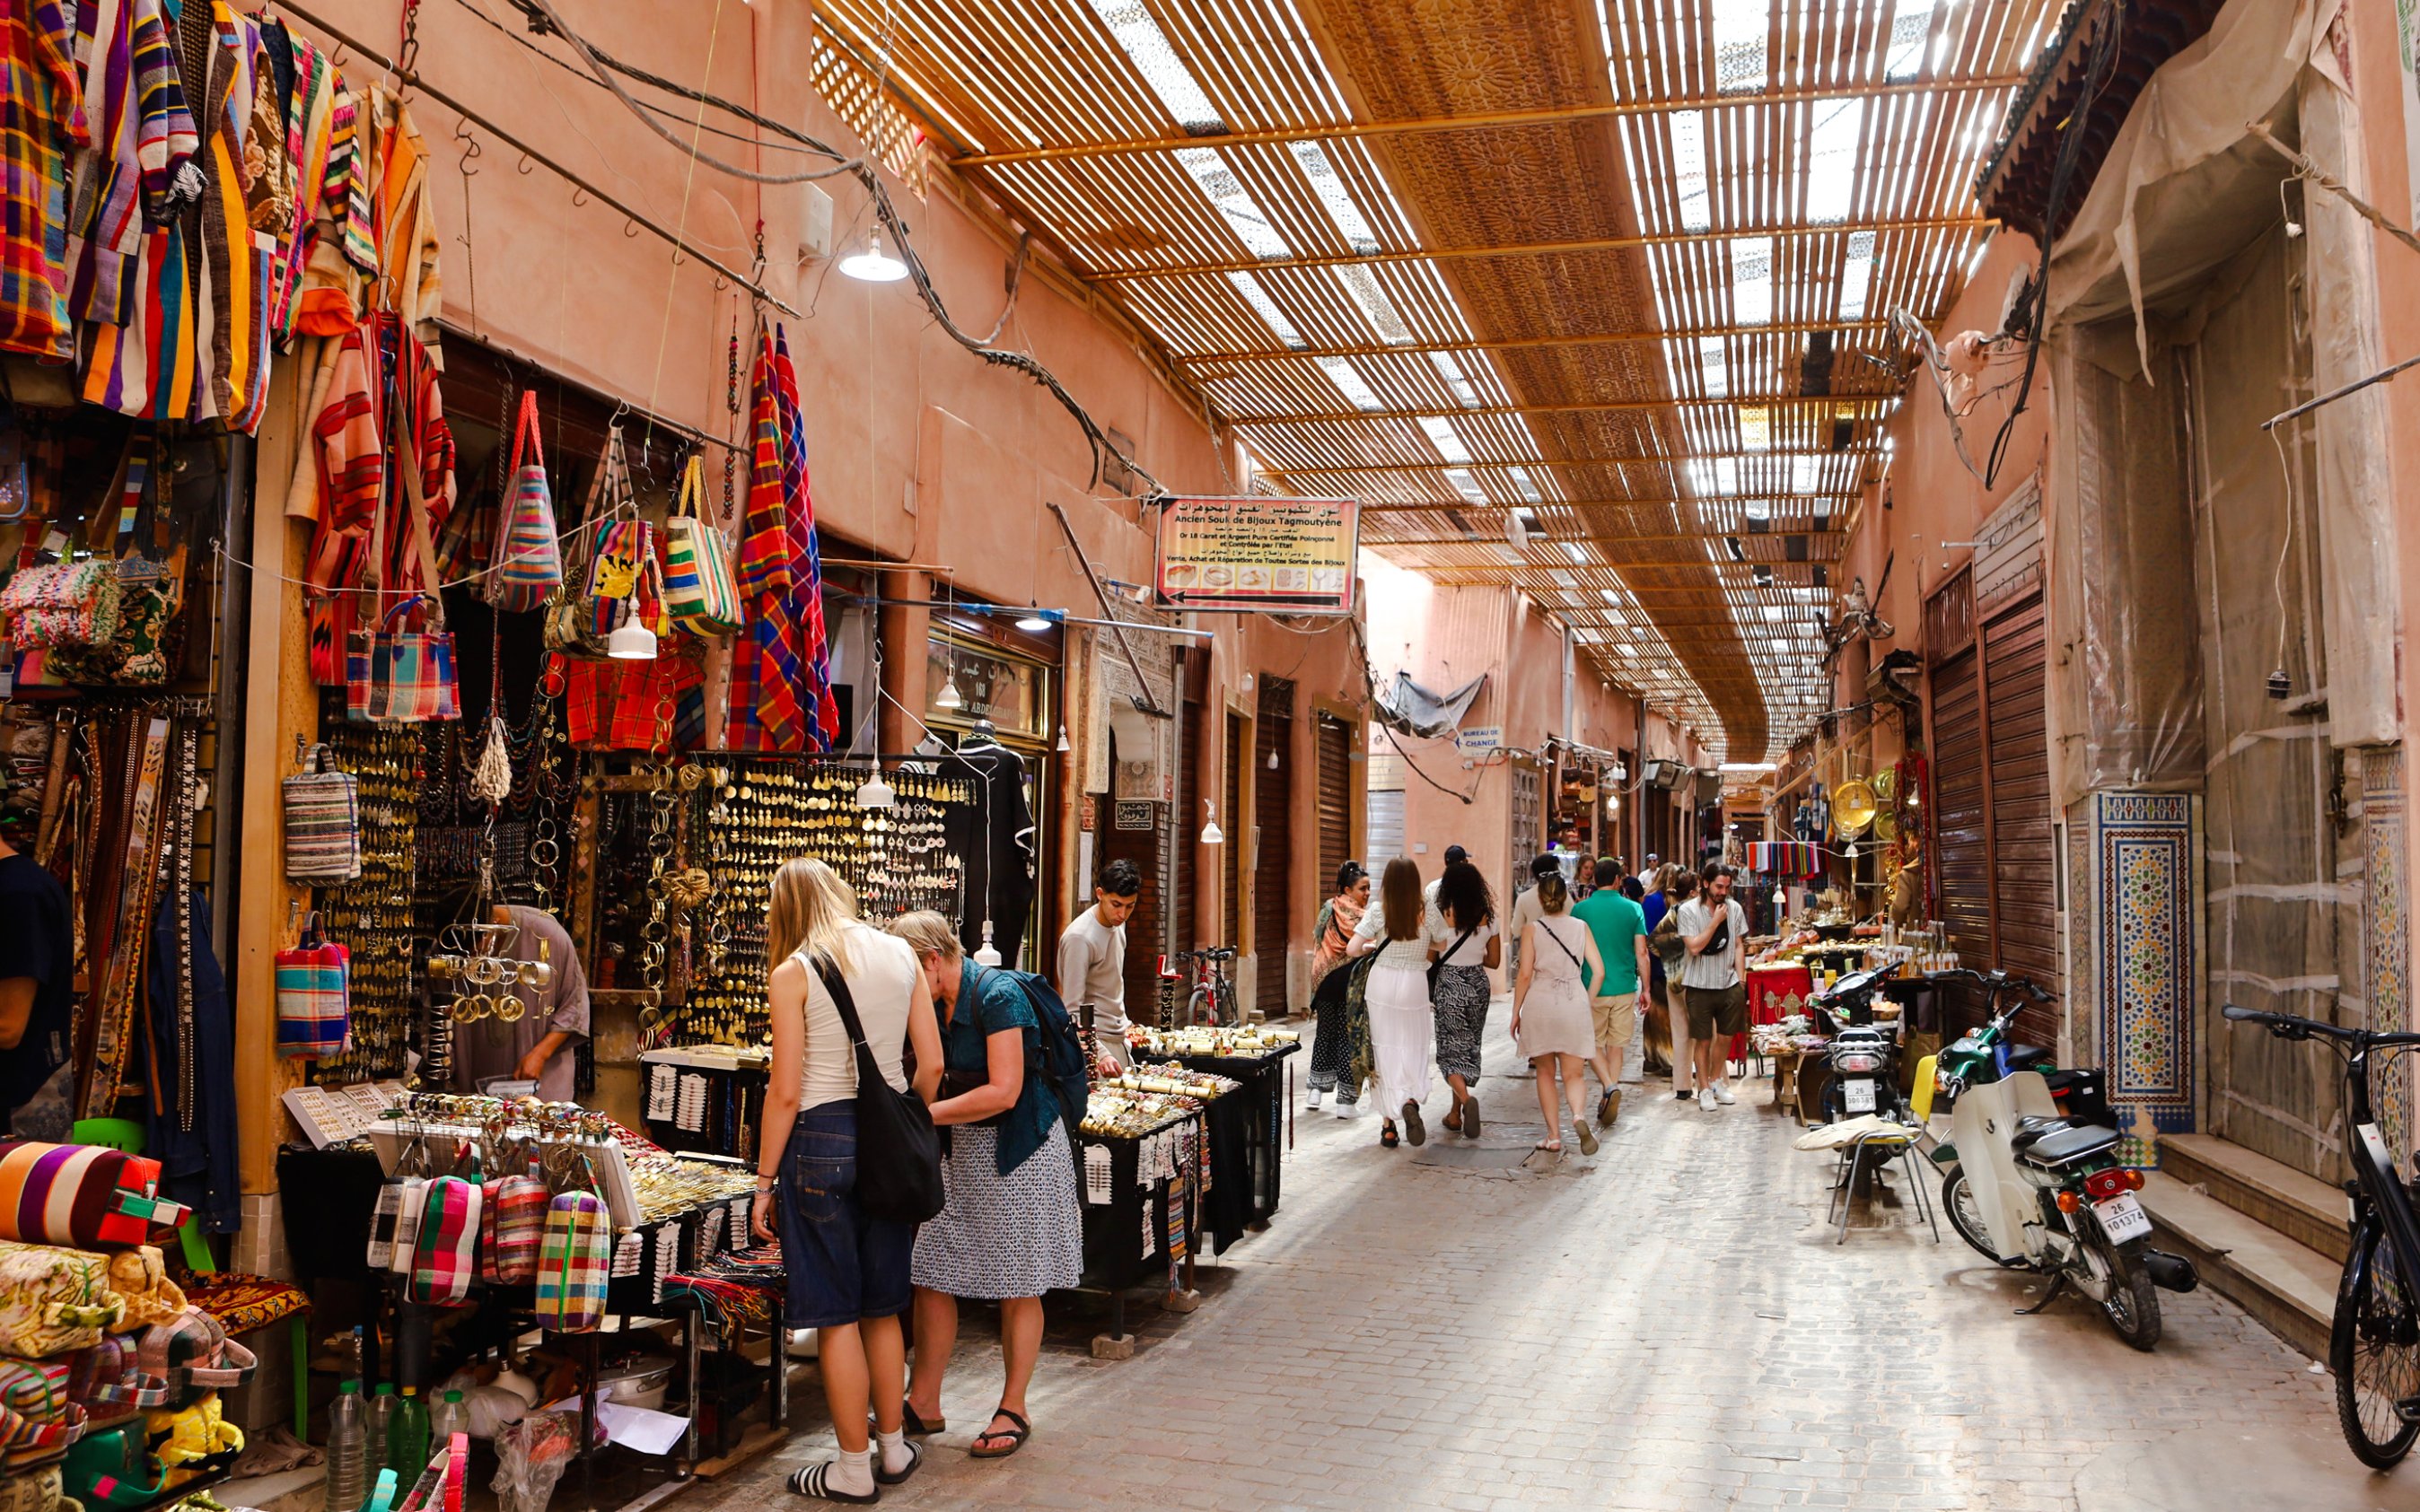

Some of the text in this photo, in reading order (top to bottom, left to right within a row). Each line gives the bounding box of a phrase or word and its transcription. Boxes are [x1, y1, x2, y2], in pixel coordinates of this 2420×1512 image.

[1208, 515, 1230, 524] Souk
[1233, 516, 1244, 524] de
[1248, 517, 1276, 526] Bijoux
[1278, 517, 1342, 528] Tagmoutyène
[2111, 1202, 2125, 1215] 26
[2108, 1211, 2144, 1232] 101374
